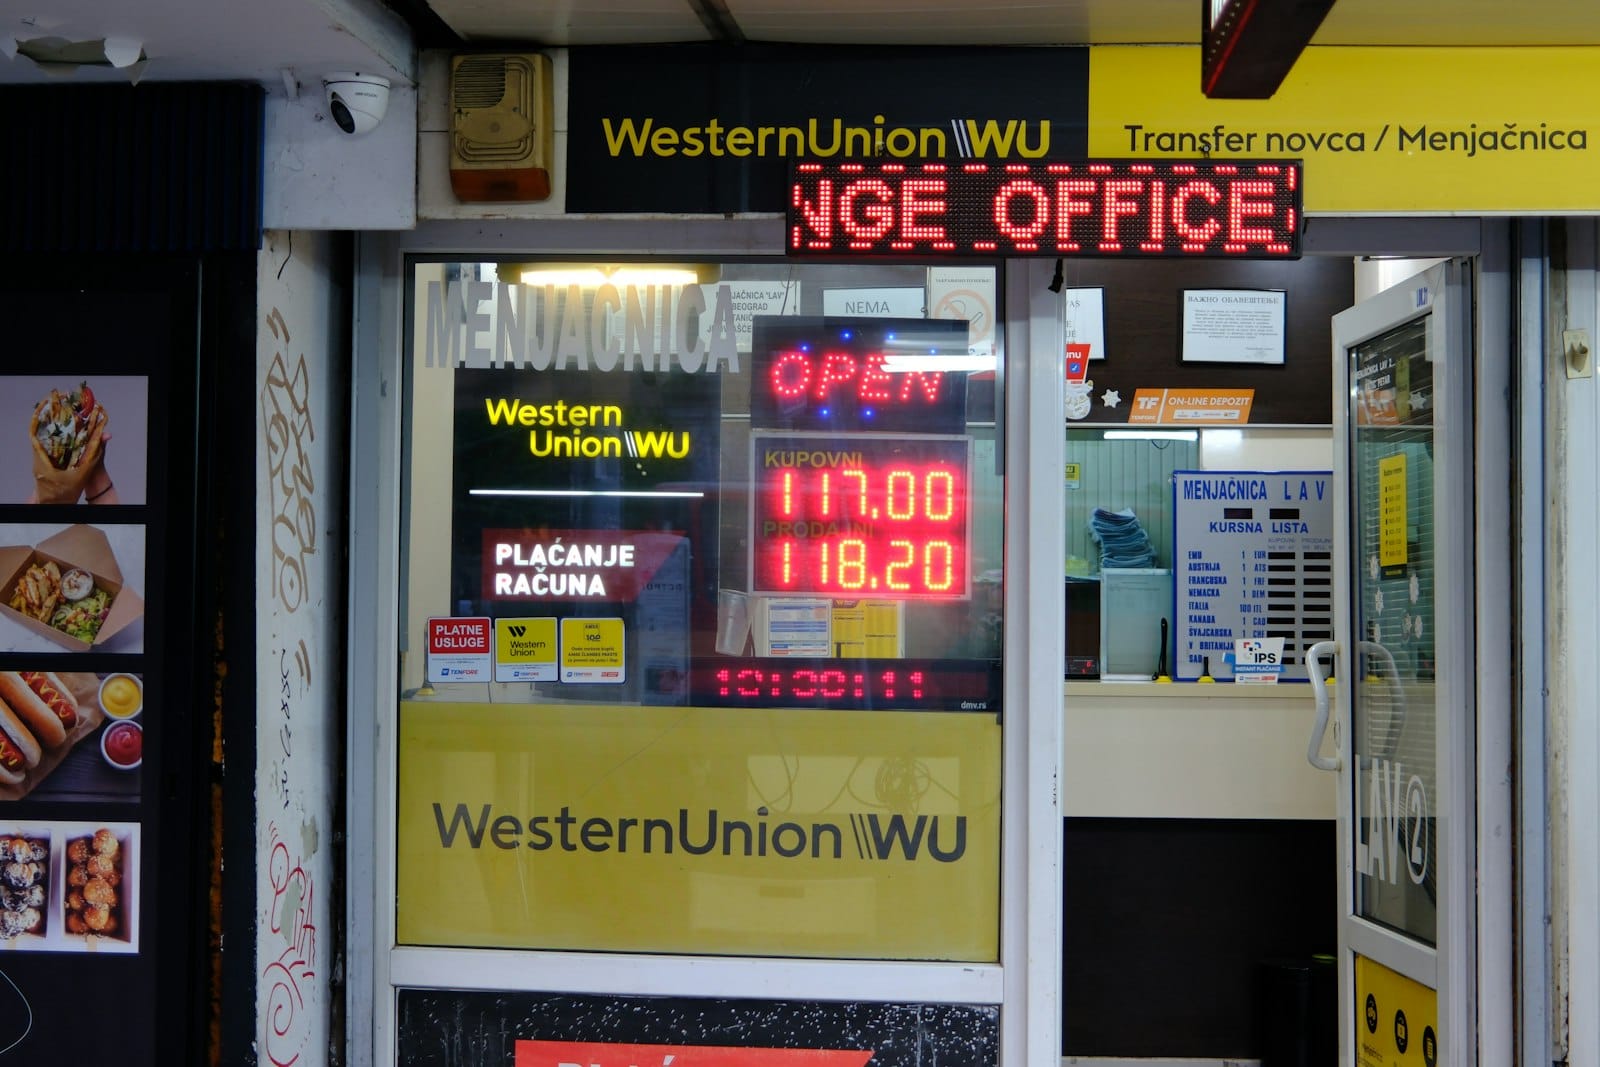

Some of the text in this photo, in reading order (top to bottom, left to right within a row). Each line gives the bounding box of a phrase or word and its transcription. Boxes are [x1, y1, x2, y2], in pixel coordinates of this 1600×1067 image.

[1124, 124, 1257, 154] Transfer
[1266, 132, 1366, 153] novca
[1398, 122, 1588, 157] Menjačnica
[994, 179, 1276, 242] OFFICE
[845, 301, 890, 314] NEMA
[773, 353, 940, 402] OPEN
[1168, 397, 1208, 406] ON-LINE
[1209, 397, 1250, 406] DEPOZIT
[485, 398, 622, 427] Western
[529, 428, 622, 457] Union
[764, 450, 863, 469] KUPOVNI
[784, 470, 954, 520] 117.00
[1183, 476, 1268, 500] MENJAČNICA
[1209, 522, 1309, 534] KURSNA LISTA
[496, 537, 635, 567] PLAĆANJE
[783, 540, 953, 590] 118.20
[1188, 563, 1220, 571] AUSTRIJA
[495, 567, 606, 596] RAČUNA
[1188, 576, 1227, 585] FRANCUSKA
[1188, 615, 1215, 624] KANADA
[436, 625, 483, 635] PLATNE
[435, 637, 485, 648] USLUGE
[510, 649, 535, 657] Union
[1255, 653, 1276, 663] IPS
[960, 700, 987, 710] dmv.rs
[1355, 754, 1401, 885] LAV
